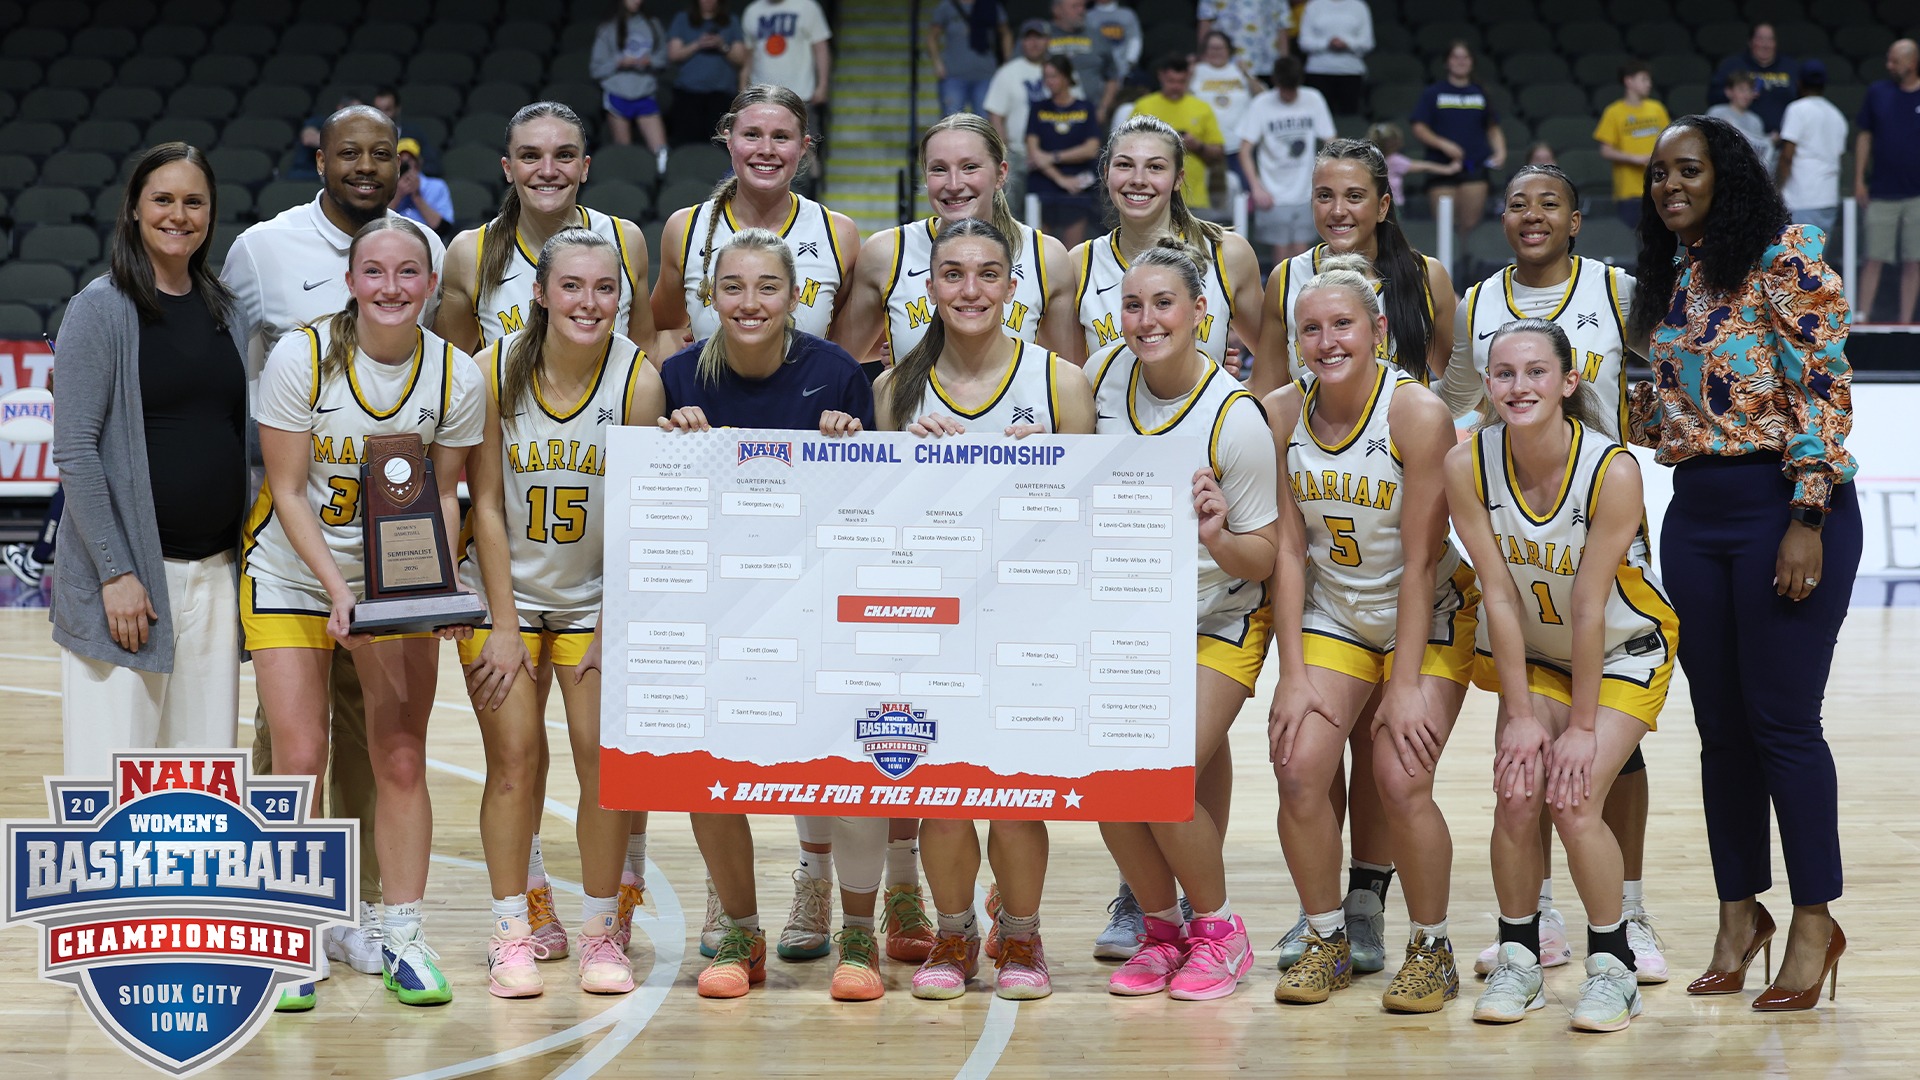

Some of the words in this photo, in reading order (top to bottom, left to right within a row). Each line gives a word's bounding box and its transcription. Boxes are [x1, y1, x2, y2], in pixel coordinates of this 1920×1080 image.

[4, 403, 53, 422] NAIA
[508, 438, 605, 476] MARIA
[739, 443, 791, 463] NAIA
[803, 442, 902, 463] NATIONAL
[914, 444, 1066, 466] CHAMPIONSHIP
[320, 475, 361, 526] 3
[1288, 470, 1398, 510] MARIAN
[526, 484, 589, 544] 15
[387, 548, 432, 558] SEMIFINALIST
[1323, 514, 1362, 567] 5
[1495, 534, 1585, 576] ARIA
[864, 605, 936, 618] CHAMPION
[1530, 580, 1564, 626] 1
[882, 704, 912, 714] NAIA
[858, 721, 934, 738] BASKETBALL
[866, 742, 926, 752] CHAMPIONSHIP
[733, 782, 820, 803] BATTLE
[822, 784, 865, 804] FOR
[870, 786, 915, 806] THE
[914, 787, 962, 806] RED
[962, 788, 1056, 808] BANNER
